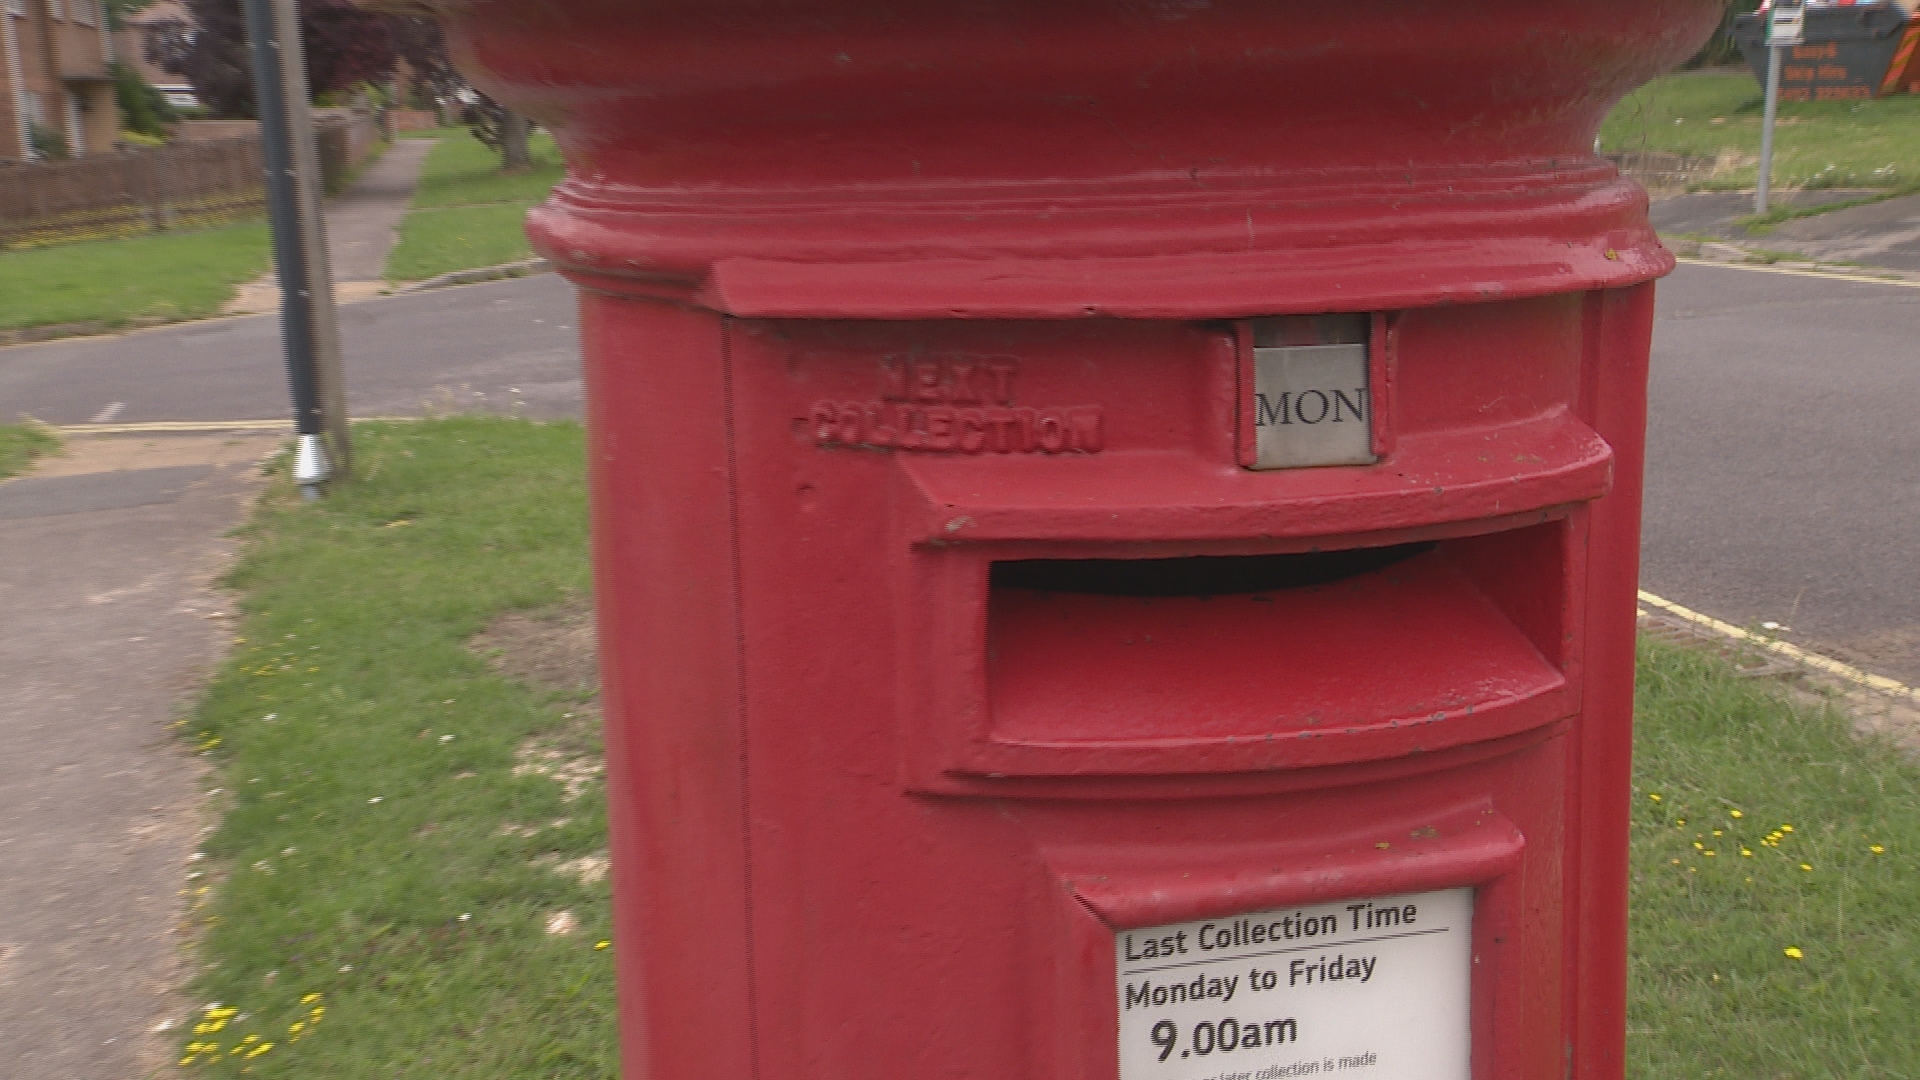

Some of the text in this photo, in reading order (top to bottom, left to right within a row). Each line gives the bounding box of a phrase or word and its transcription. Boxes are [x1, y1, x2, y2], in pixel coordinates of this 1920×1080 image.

[881, 355, 1019, 406] NEXT
[808, 401, 1105, 454] COLLECTION
[1255, 387, 1367, 427] MON
[1124, 903, 1418, 962] Last Collection Time
[1125, 954, 1377, 1011] Monday to Friday
[1150, 1017, 1298, 1062] 9.00am
[1255, 1060, 1320, 1080] collection
[1323, 1056, 1335, 1072] is
[1338, 1050, 1377, 1070] made
